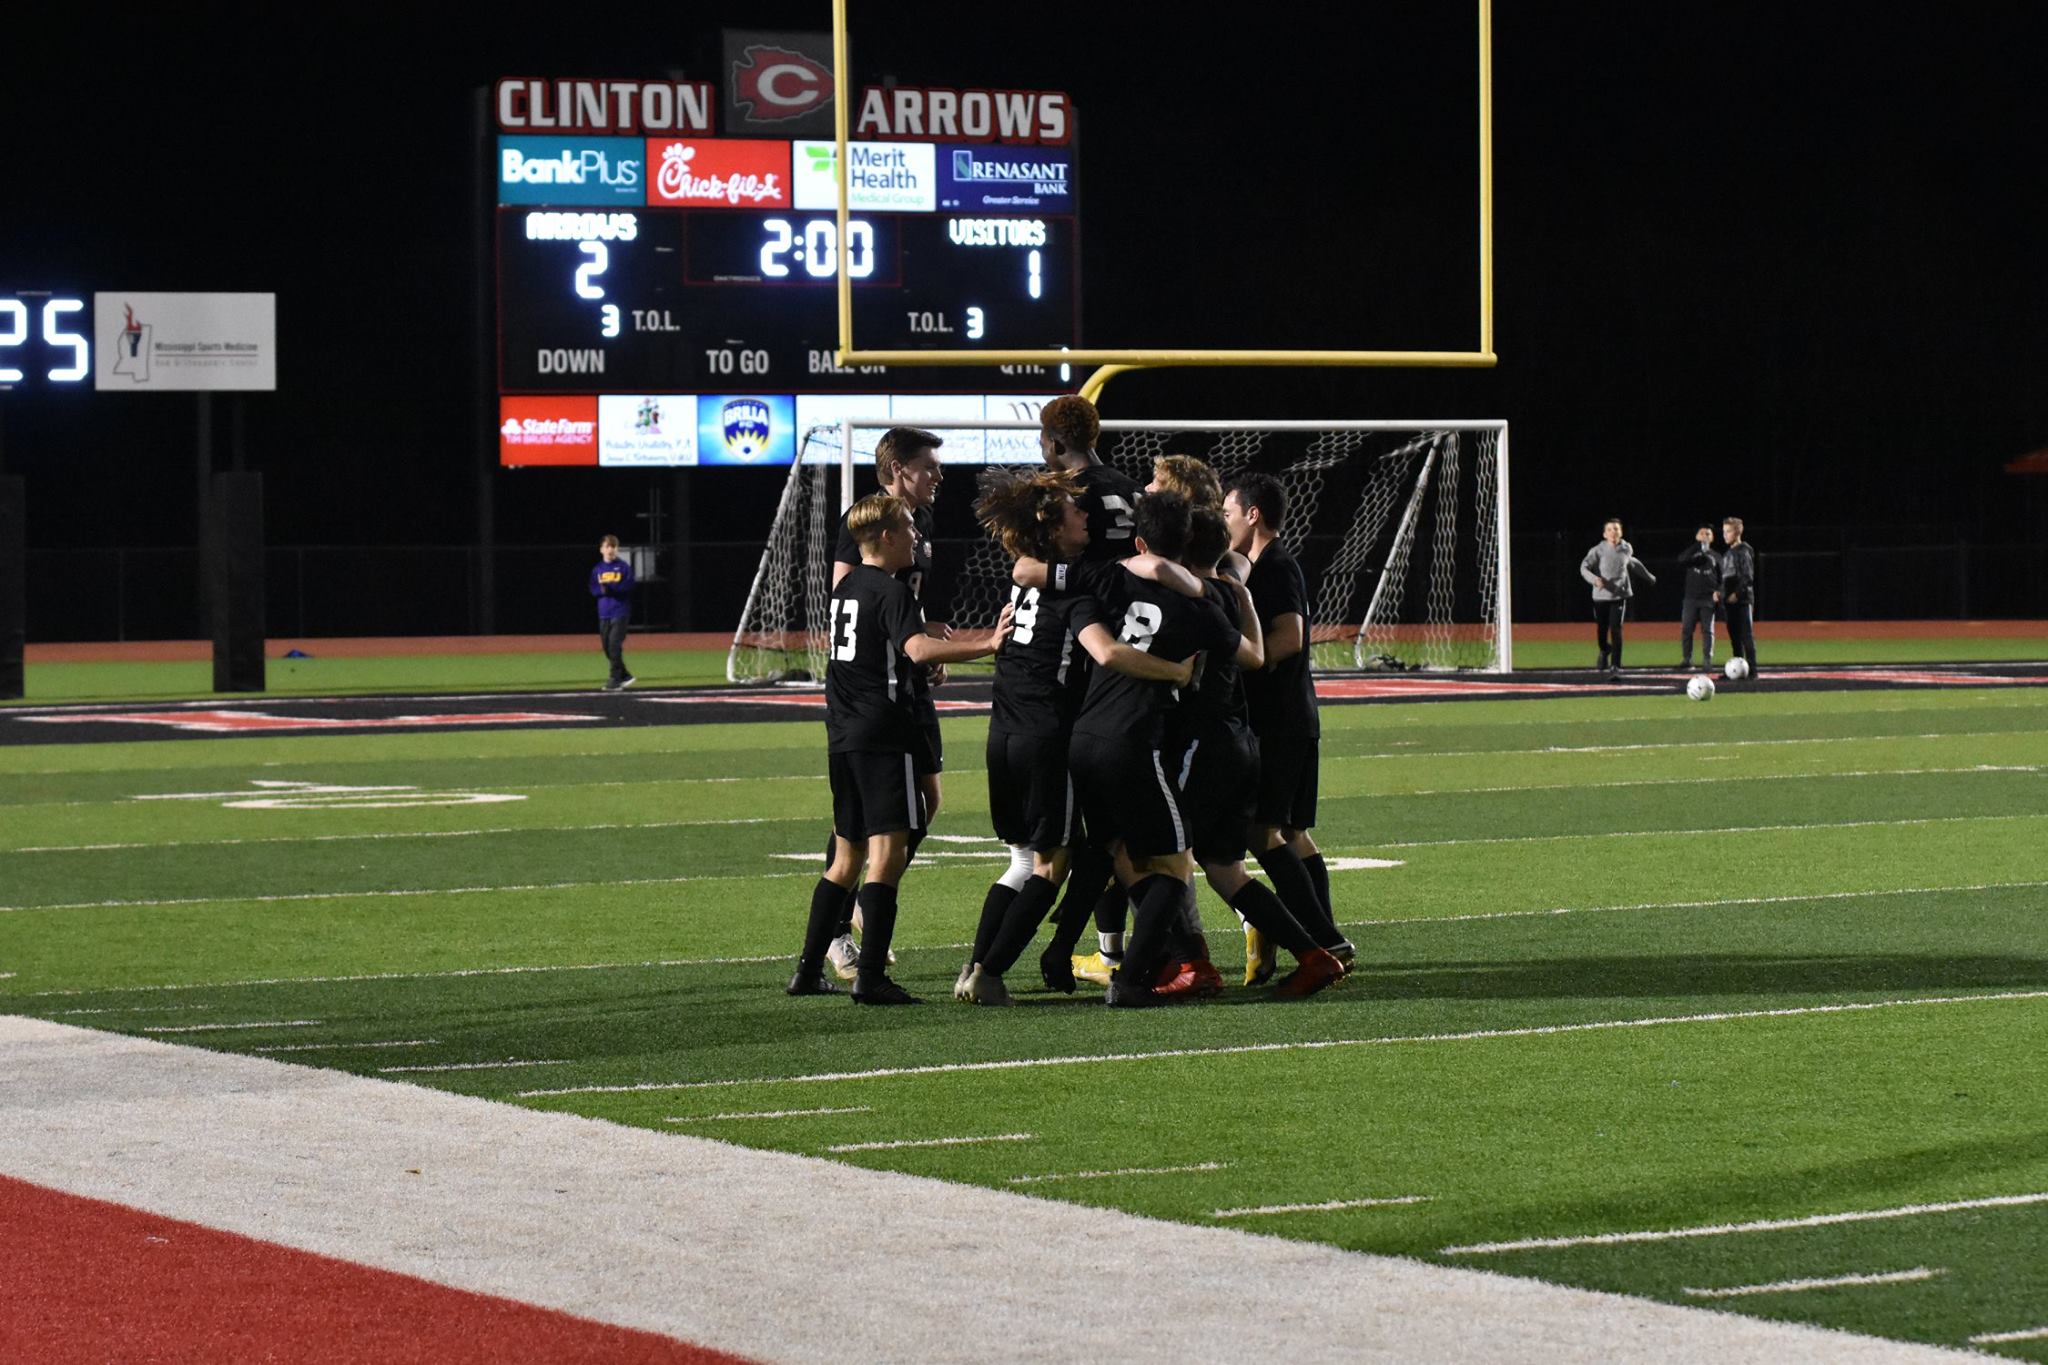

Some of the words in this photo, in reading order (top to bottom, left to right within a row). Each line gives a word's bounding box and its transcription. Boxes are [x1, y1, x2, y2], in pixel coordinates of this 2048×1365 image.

[499, 80, 708, 130] CLINTON
[857, 89, 1065, 138] ARROWS
[502, 149, 640, 184] BankPlus
[851, 147, 906, 168] Merit
[972, 162, 1067, 180] RENASANT
[657, 157, 782, 204] Chick-fil-A
[851, 168, 917, 189] Health
[1034, 183, 1067, 195] BANK
[949, 218, 1046, 246] VISITORS
[760, 219, 874, 278] 2:00
[575, 240, 609, 300] 2
[1028, 250, 1042, 299] 1
[601, 304, 620, 337] 3
[632, 310, 681, 331] T.O.L.
[908, 312, 954, 332] T.O.L.
[966, 307, 985, 338] 3
[538, 349, 605, 373] DOWN
[706, 350, 734, 373] TO
[740, 350, 770, 373] GO
[724, 405, 768, 426] BRILLA
[830, 599, 859, 662] 13
